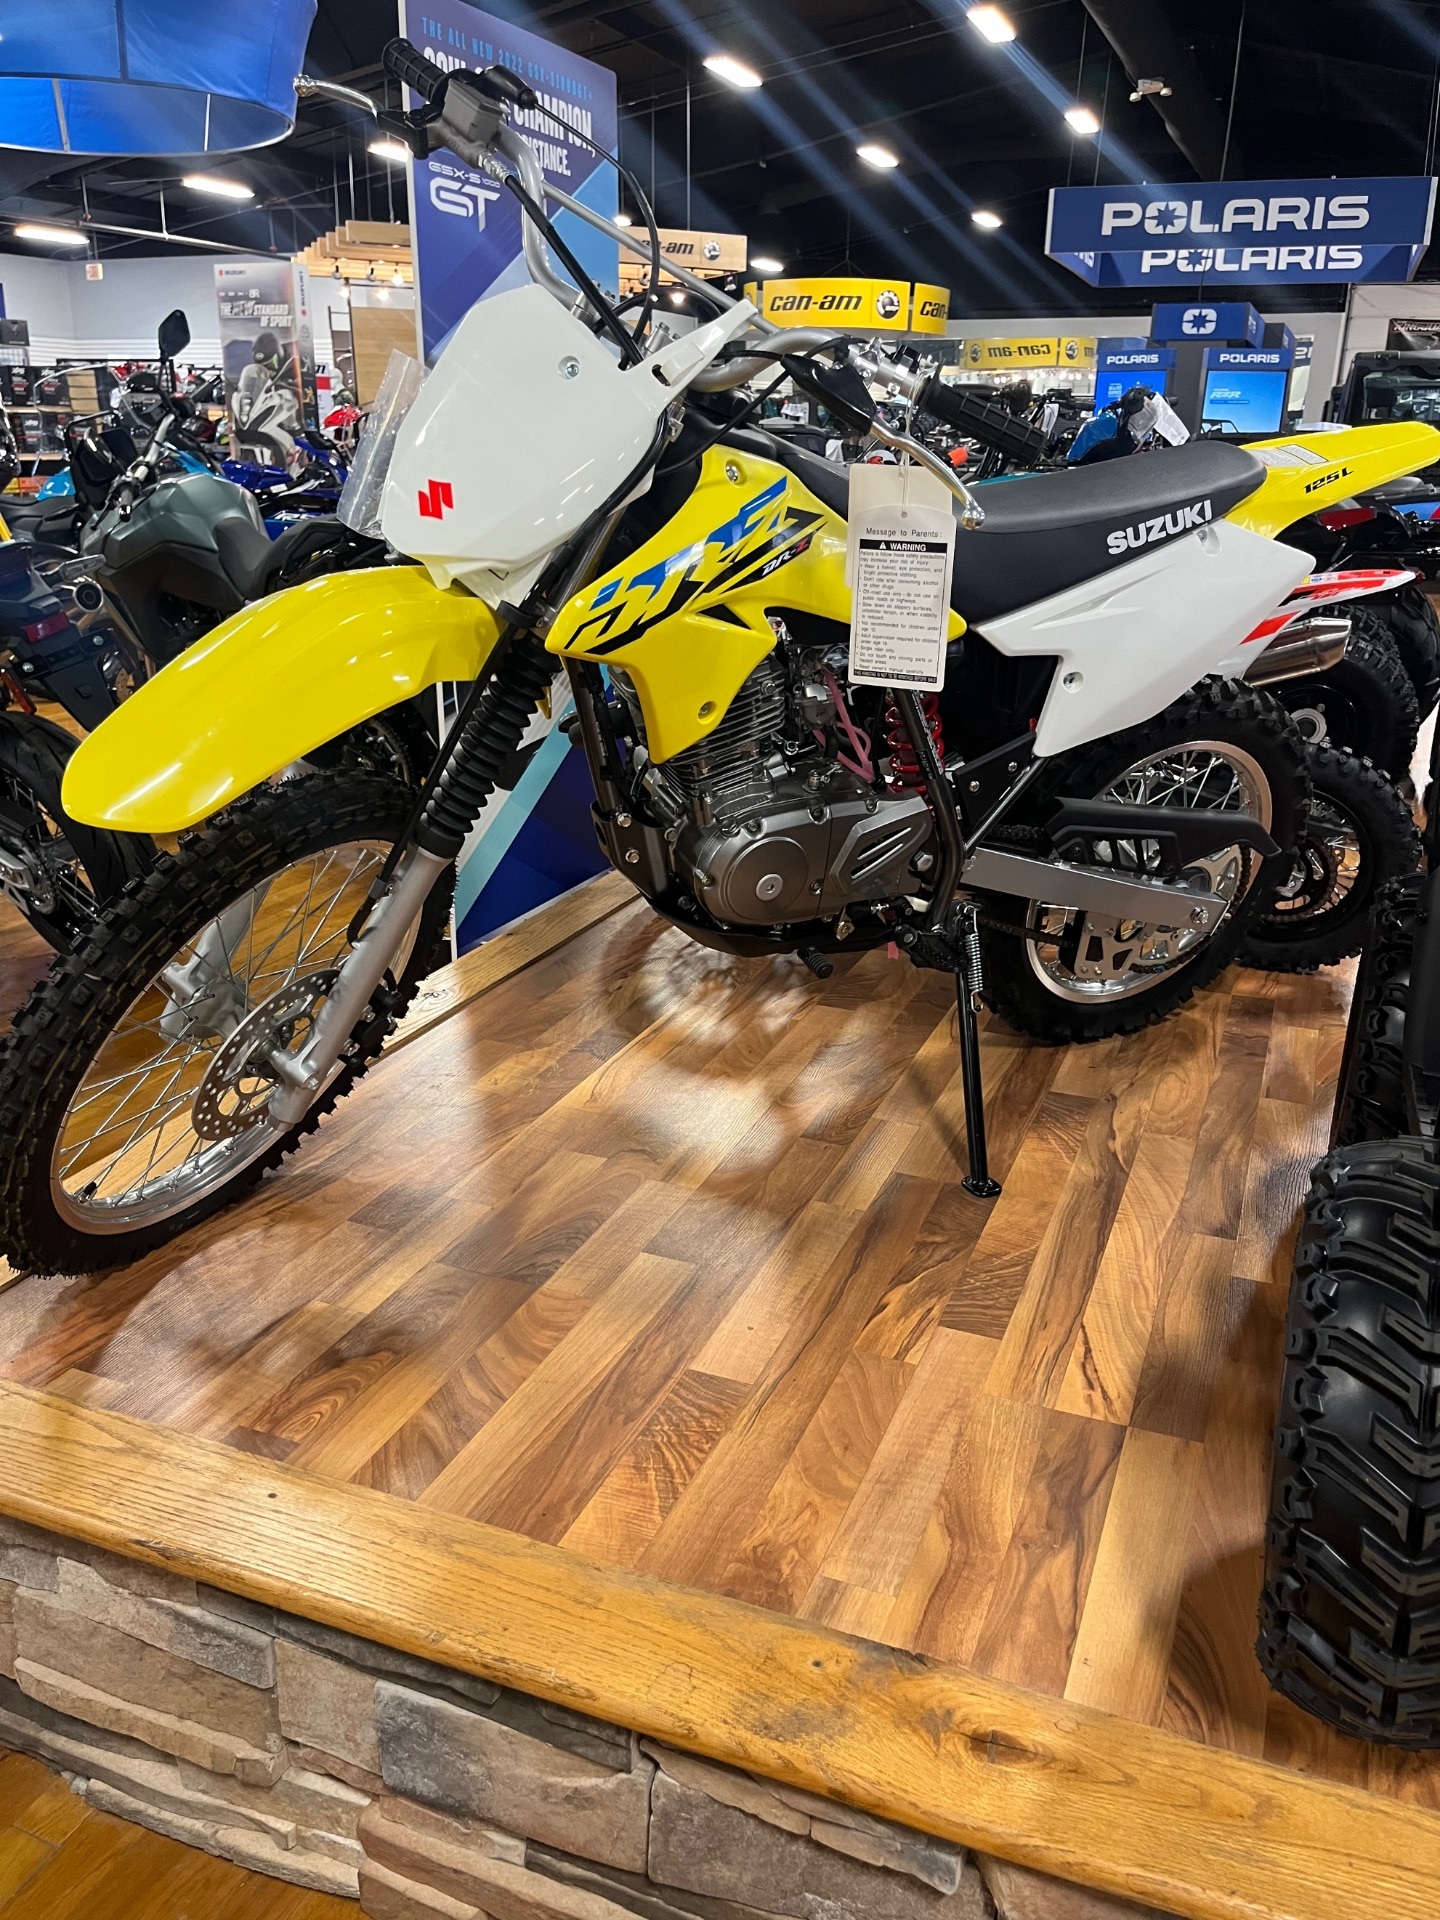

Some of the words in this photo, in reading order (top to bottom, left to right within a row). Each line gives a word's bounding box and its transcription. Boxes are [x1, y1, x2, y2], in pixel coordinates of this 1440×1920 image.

[422, 17, 442, 41] THE
[448, 28, 467, 50] ALL
[472, 38, 493, 61] NEW
[498, 49, 524, 74] 2022
[430, 177, 500, 233] GT
[1101, 195, 1370, 236] POLARIS
[1141, 246, 1364, 274] POLARIS
[770, 294, 863, 312] can-am
[1106, 354, 1159, 365] POLARIS
[1219, 353, 1280, 364] POLARIS
[865, 527, 896, 538] Message
[1106, 500, 1213, 555] SUZUKI
[762, 538, 809, 577] DR-Z
[889, 542, 927, 552] WARNING
